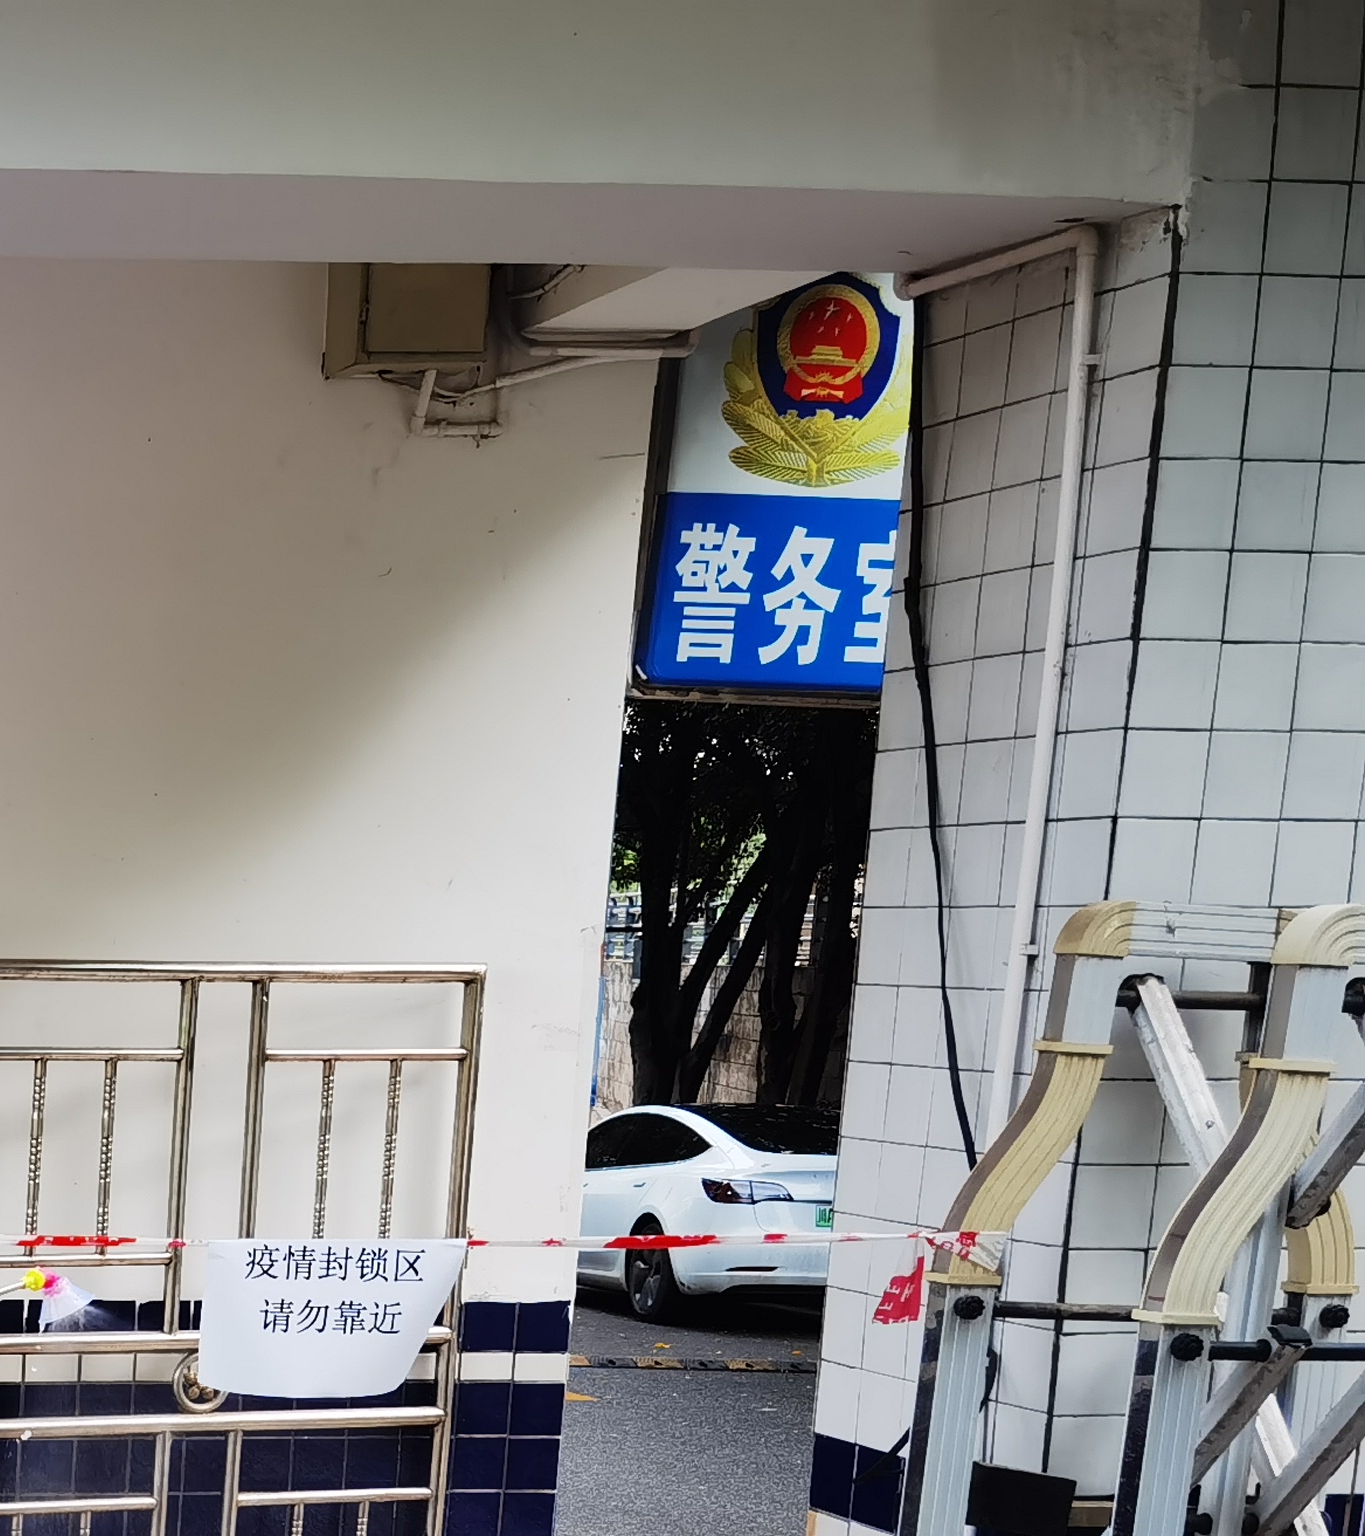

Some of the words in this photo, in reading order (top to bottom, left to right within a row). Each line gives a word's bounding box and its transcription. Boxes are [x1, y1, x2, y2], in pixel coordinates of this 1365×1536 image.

[245, 1243, 427, 1283] 疫情封锁区
[260, 1298, 403, 1335] 请勿靠近
